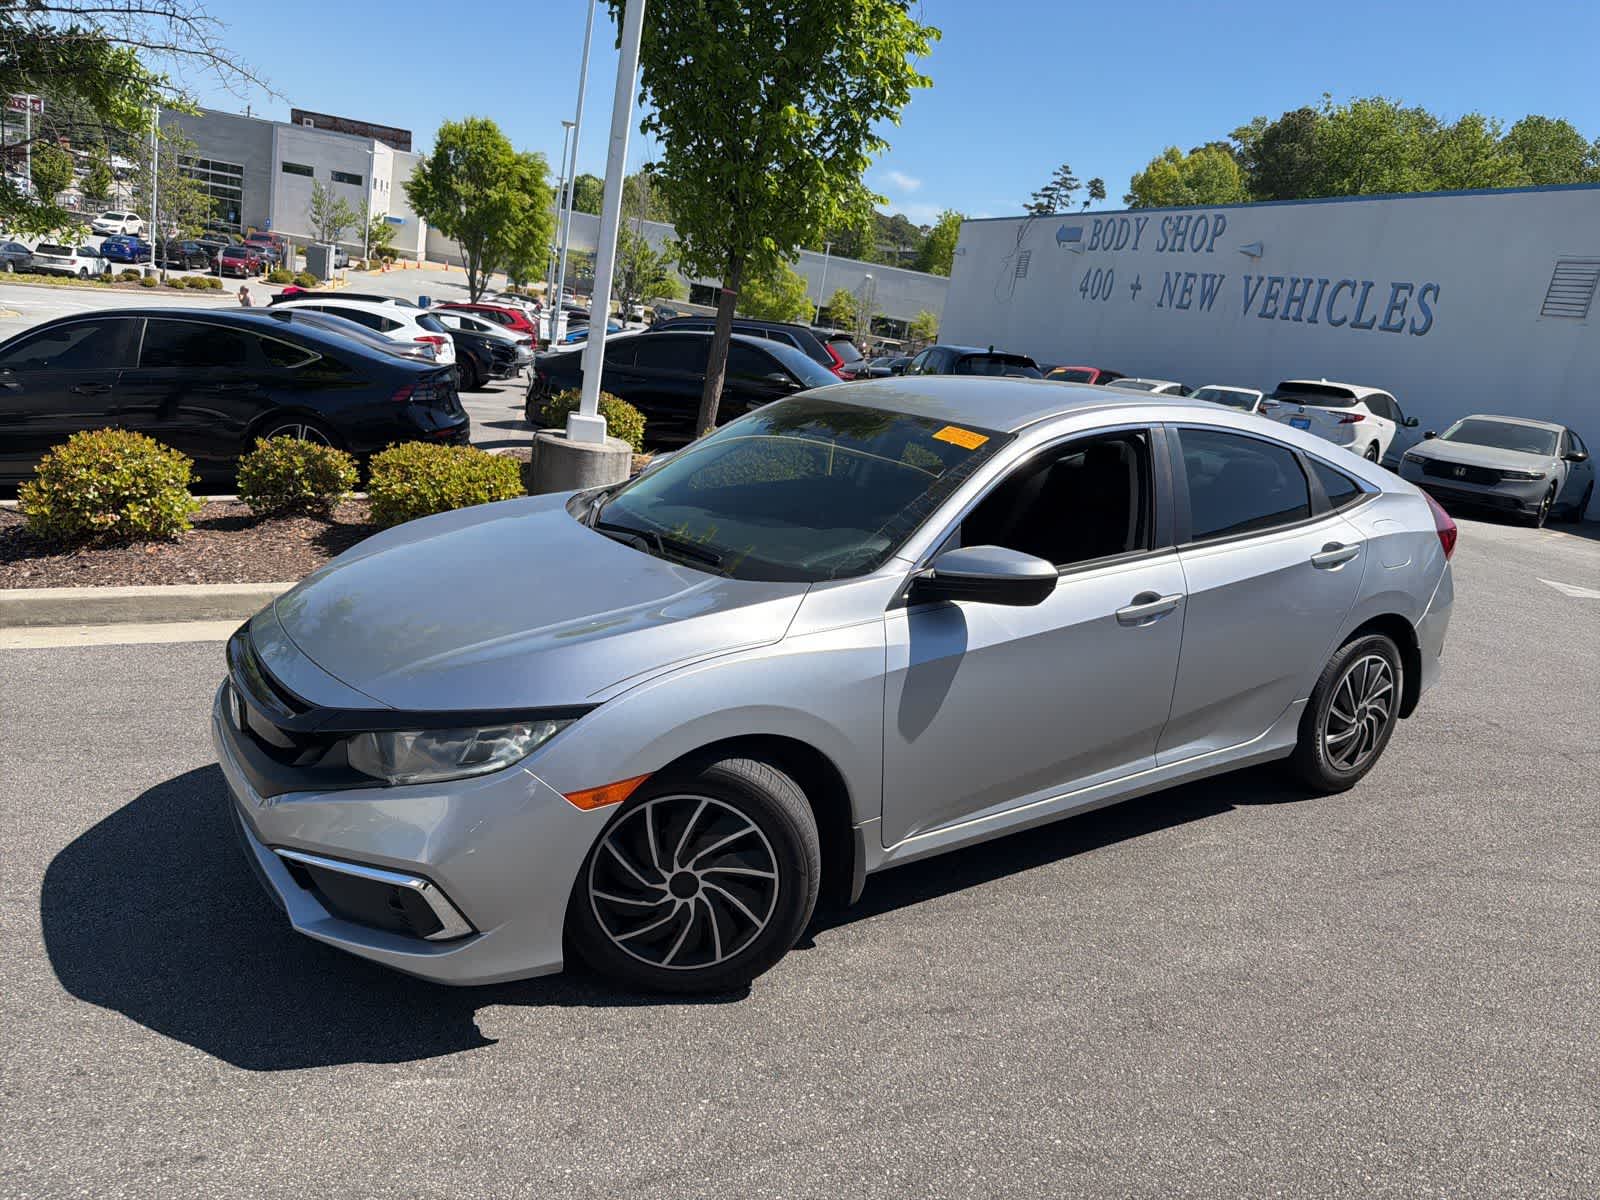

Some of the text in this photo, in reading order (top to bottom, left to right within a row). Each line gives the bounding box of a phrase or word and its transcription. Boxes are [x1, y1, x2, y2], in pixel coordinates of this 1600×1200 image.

[1087, 214, 1227, 253] BODY SHOP
[1079, 267, 1441, 337] 400 + NEW VEHICLES
